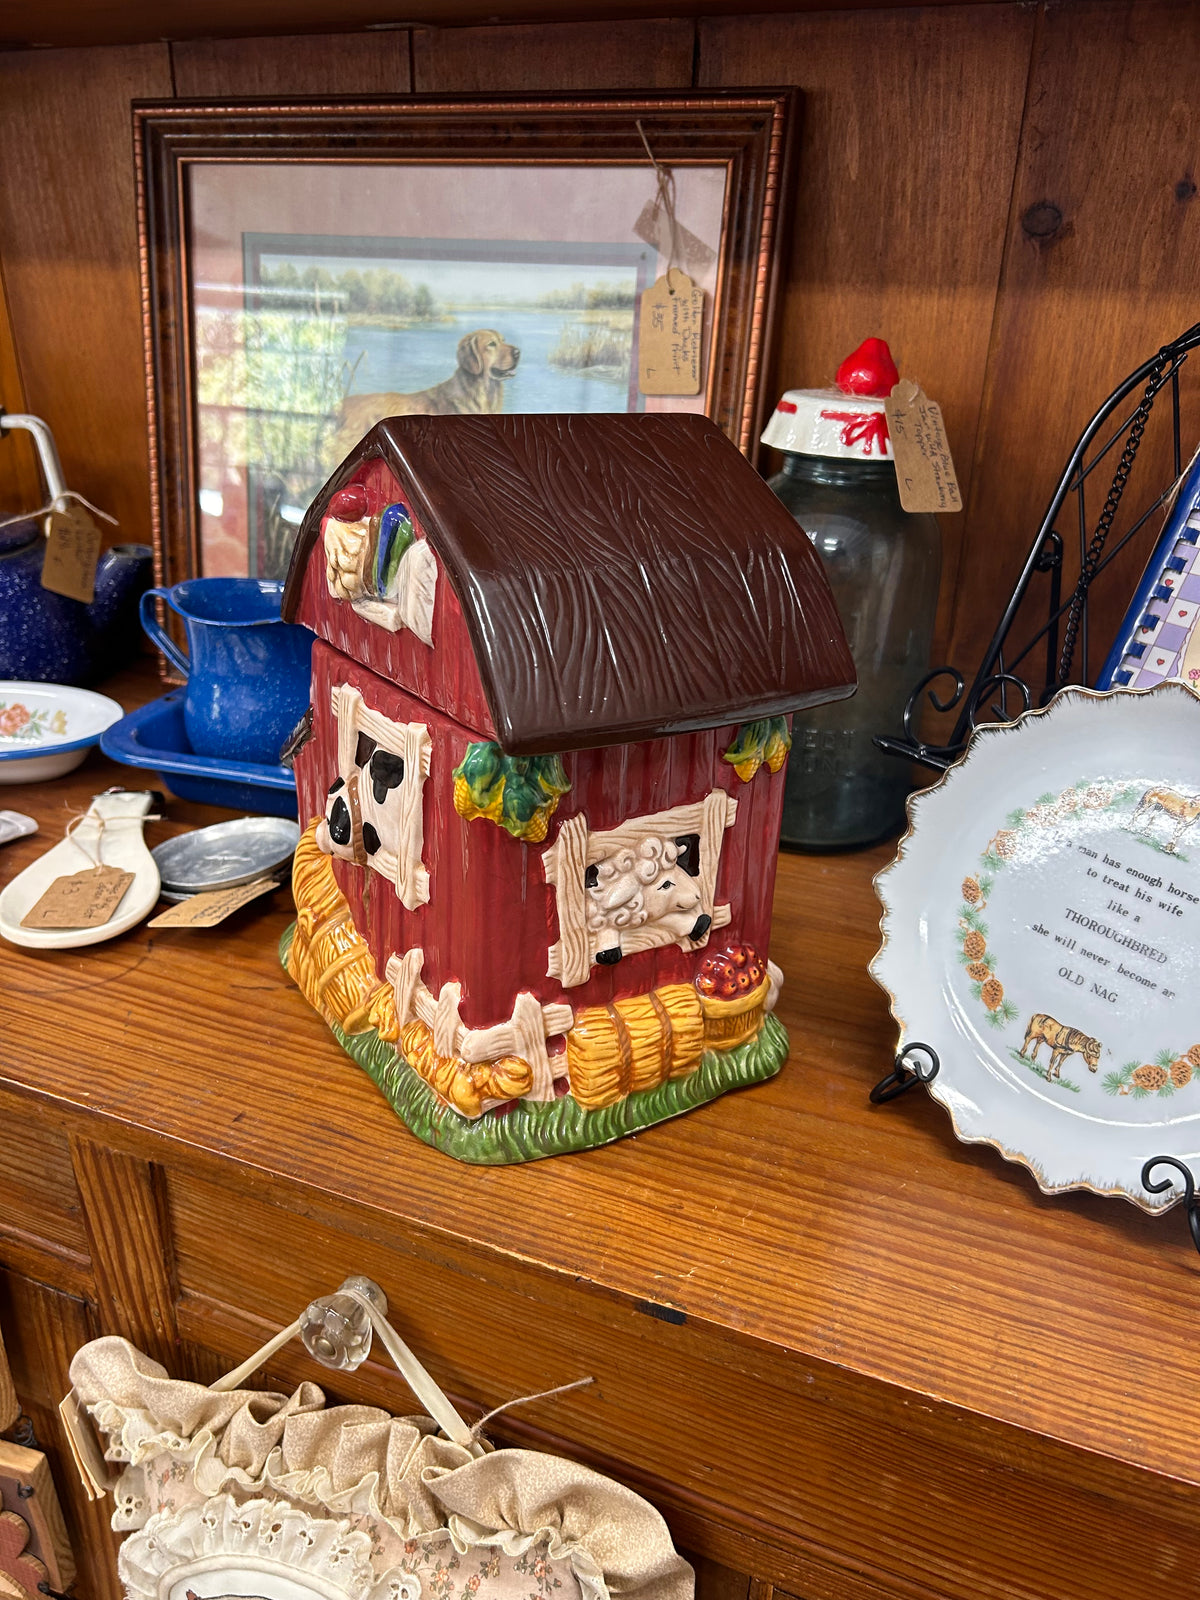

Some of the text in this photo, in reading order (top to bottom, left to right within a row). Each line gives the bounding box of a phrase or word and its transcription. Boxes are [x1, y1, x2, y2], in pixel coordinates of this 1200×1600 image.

[1078, 846, 1098, 859] man
[1102, 854, 1122, 869] has
[1126, 866, 1163, 889] enough
[1167, 882, 1200, 905] horse
[1086, 867, 1184, 917] to treat his wife
[1065, 908, 1168, 964] THOROUGHBRED
[1107, 900, 1142, 923] like a
[1032, 923, 1050, 937] she
[1054, 935, 1077, 950] will
[1080, 947, 1111, 967] never
[1116, 963, 1157, 990] become
[1058, 967, 1118, 1004] OLD NAG
